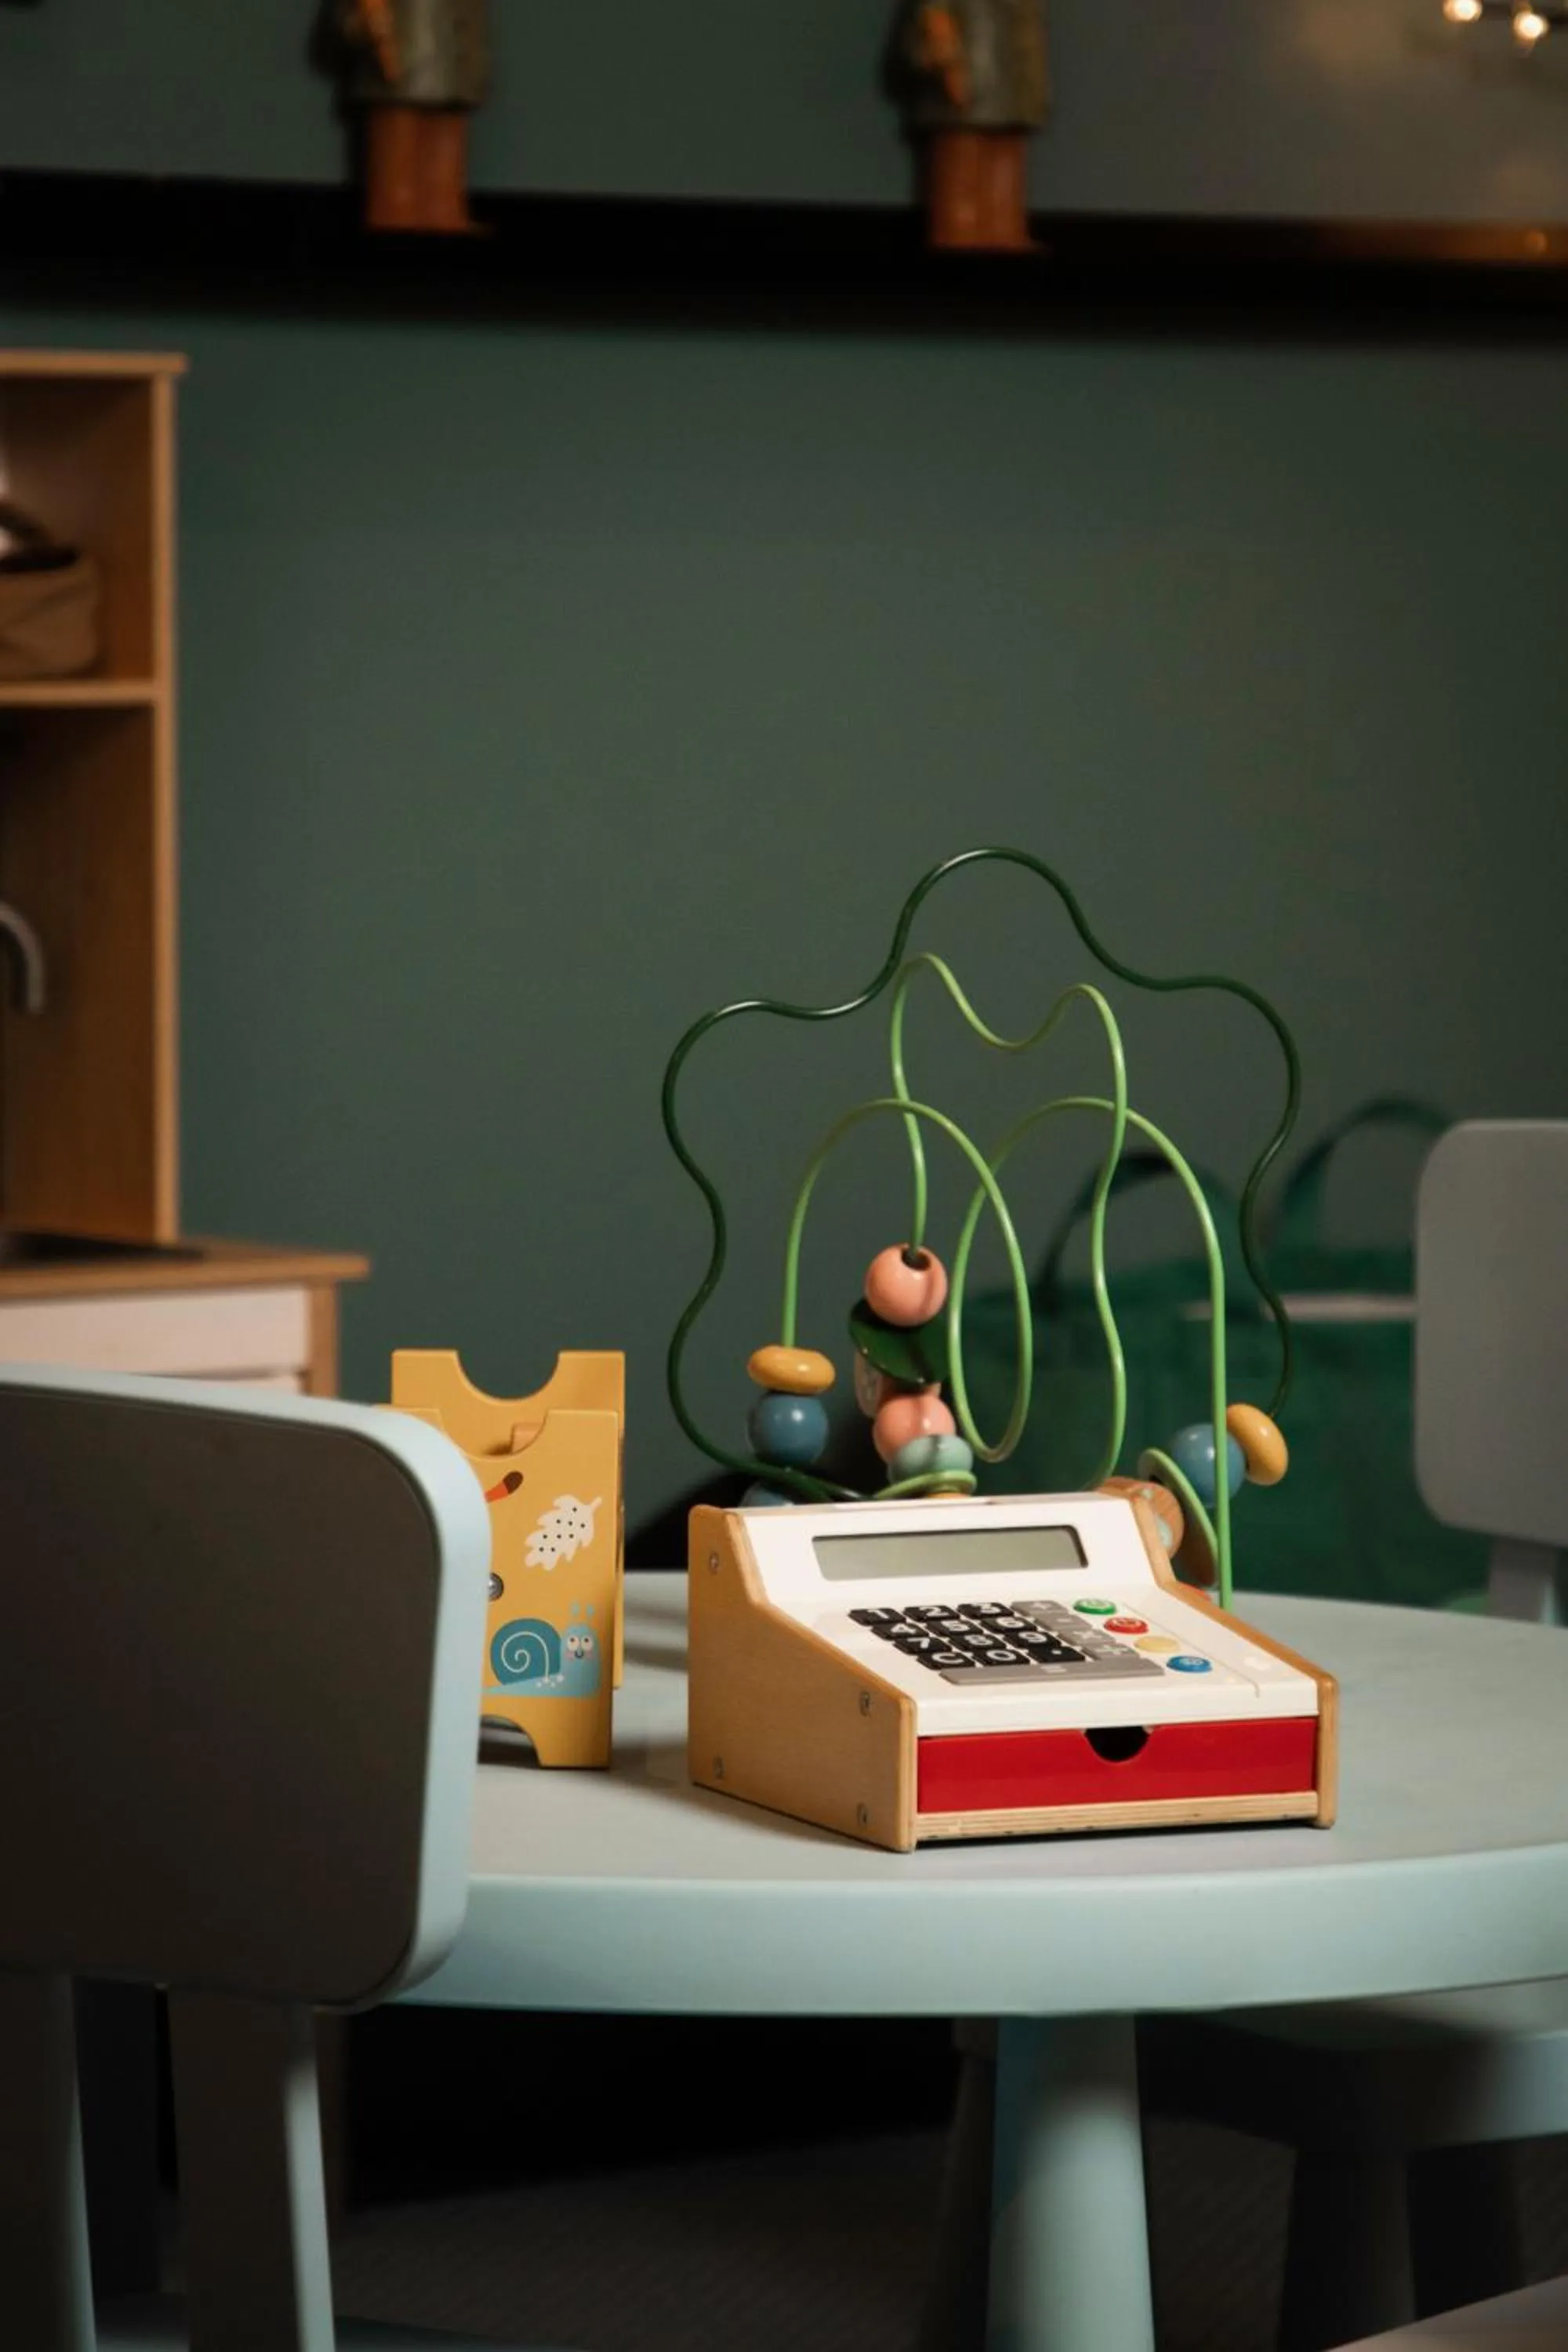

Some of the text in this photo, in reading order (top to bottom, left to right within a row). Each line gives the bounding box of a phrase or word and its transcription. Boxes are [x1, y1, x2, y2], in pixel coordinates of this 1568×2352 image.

[867, 1609, 890, 1619] 1
[919, 1607, 950, 1617] 2
[972, 1602, 1001, 1614] 3
[891, 1623, 916, 1634] 4
[941, 1621, 970, 1632] 5
[996, 1617, 1025, 1628] 6
[906, 1637, 931, 1649] 7
[964, 1634, 993, 1646] 8
[1018, 1632, 1047, 1643] 9
[931, 1653, 964, 1664] C
